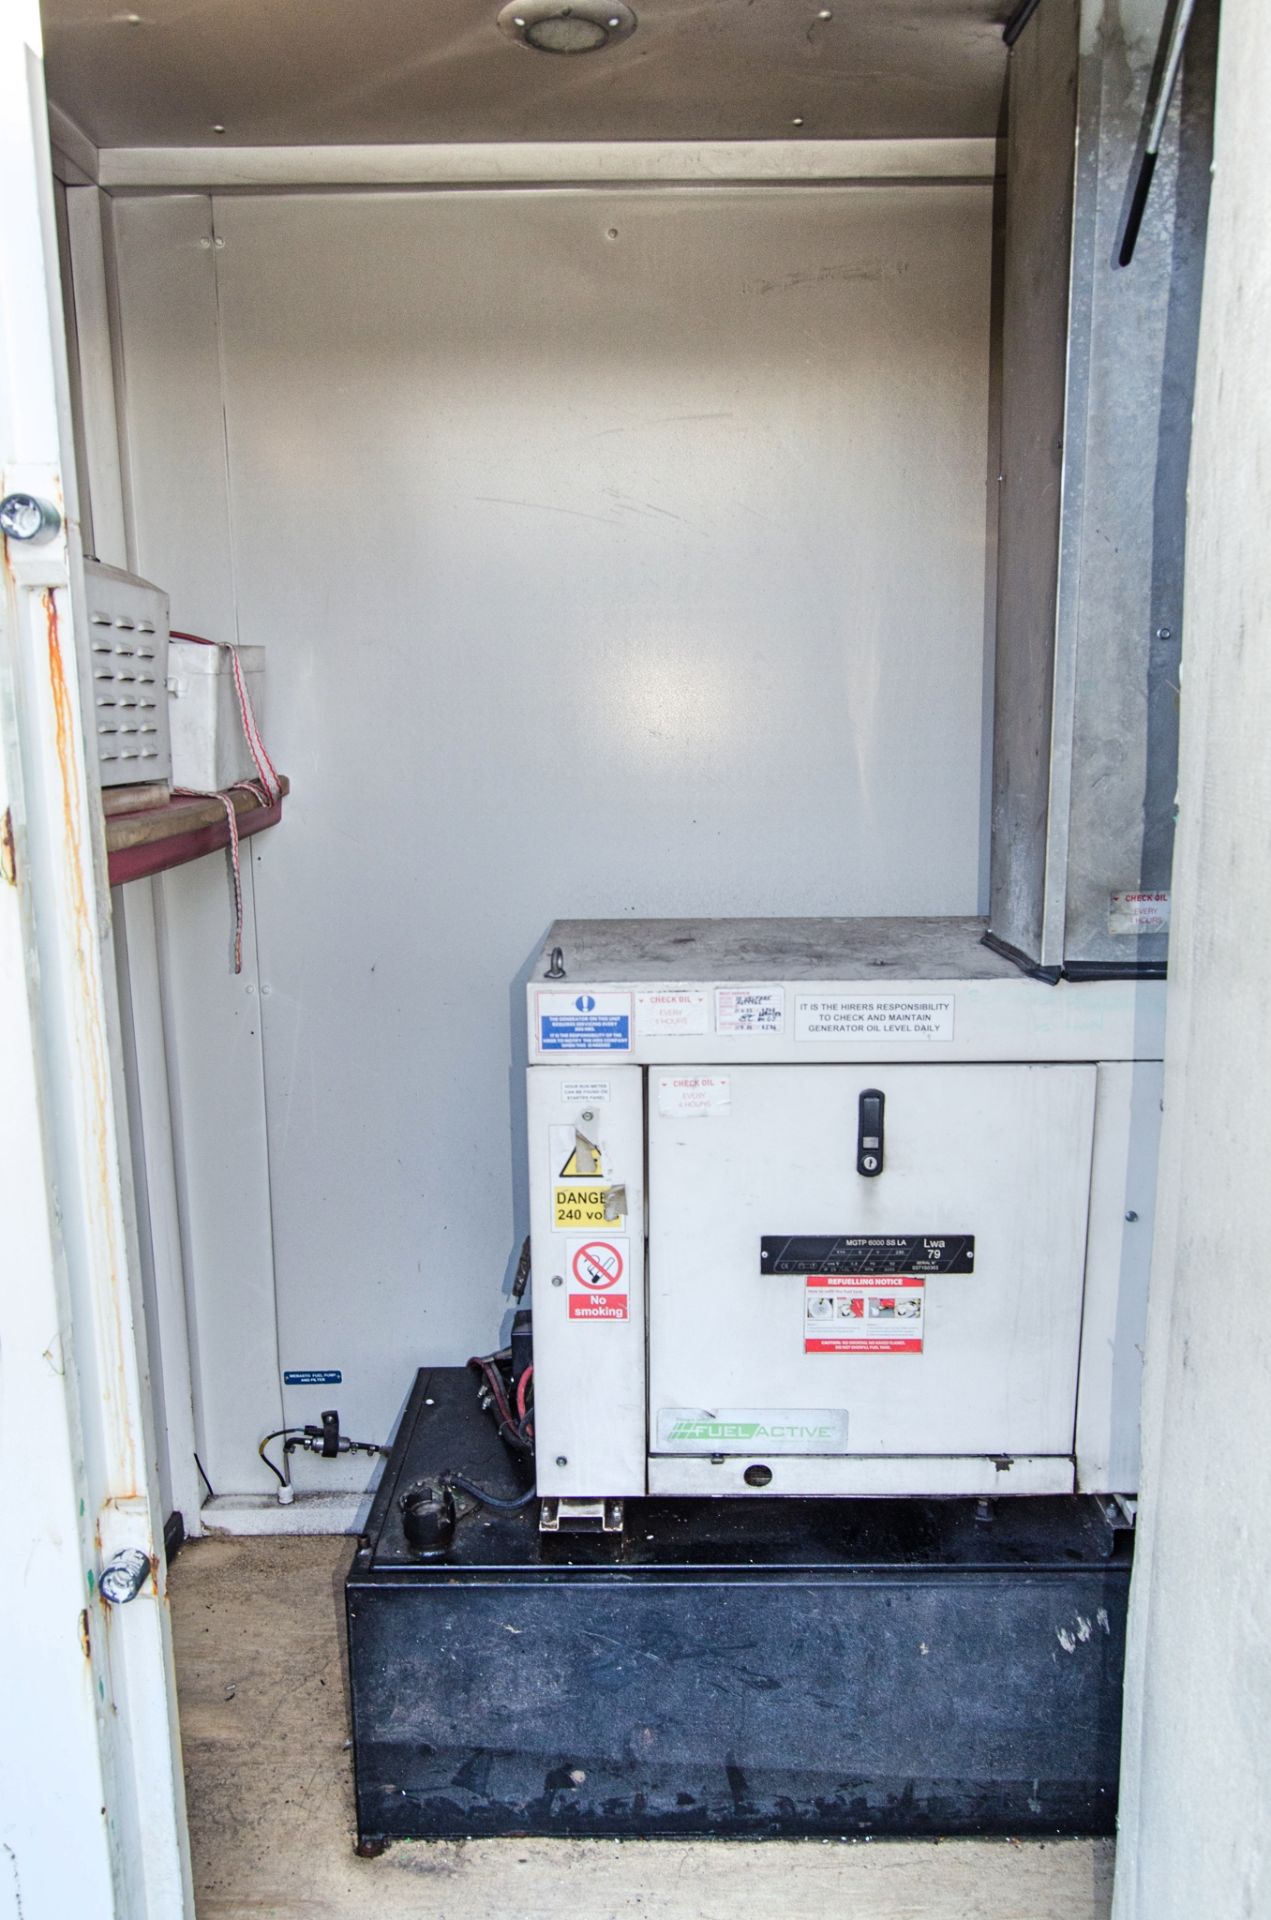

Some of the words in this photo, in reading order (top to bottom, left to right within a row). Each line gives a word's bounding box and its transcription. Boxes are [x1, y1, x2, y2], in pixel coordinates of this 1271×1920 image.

[1125, 894, 1153, 902] CHECK
[1154, 894, 1168, 902] OIL
[800, 1003, 808, 1011] IT
[810, 1003, 819, 1011] IS
[822, 1003, 838, 1011] THE
[841, 1003, 874, 1011] HIRERS
[876, 1003, 949, 1011] RESPONSIBILITY
[808, 1024, 864, 1032] GENERATOR
[866, 1024, 881, 1032] OIL
[883, 1024, 911, 1032] LEVEL
[914, 1024, 940, 1032] DAILY
[673, 1080, 700, 1088] CHECK
[701, 1079, 714, 1087] OIL
[556, 1191, 607, 1205] DANGE
[558, 1209, 582, 1220] 240
[923, 1238, 945, 1248] Lwa
[927, 1249, 941, 1259] 79
[827, 1278, 876, 1286] REFUELLING
[876, 1278, 904, 1286] NOTICE
[590, 1295, 607, 1305] No
[574, 1306, 624, 1318] smoking
[694, 1425, 752, 1437] FUEL
[754, 1426, 832, 1437] ACTIVE
